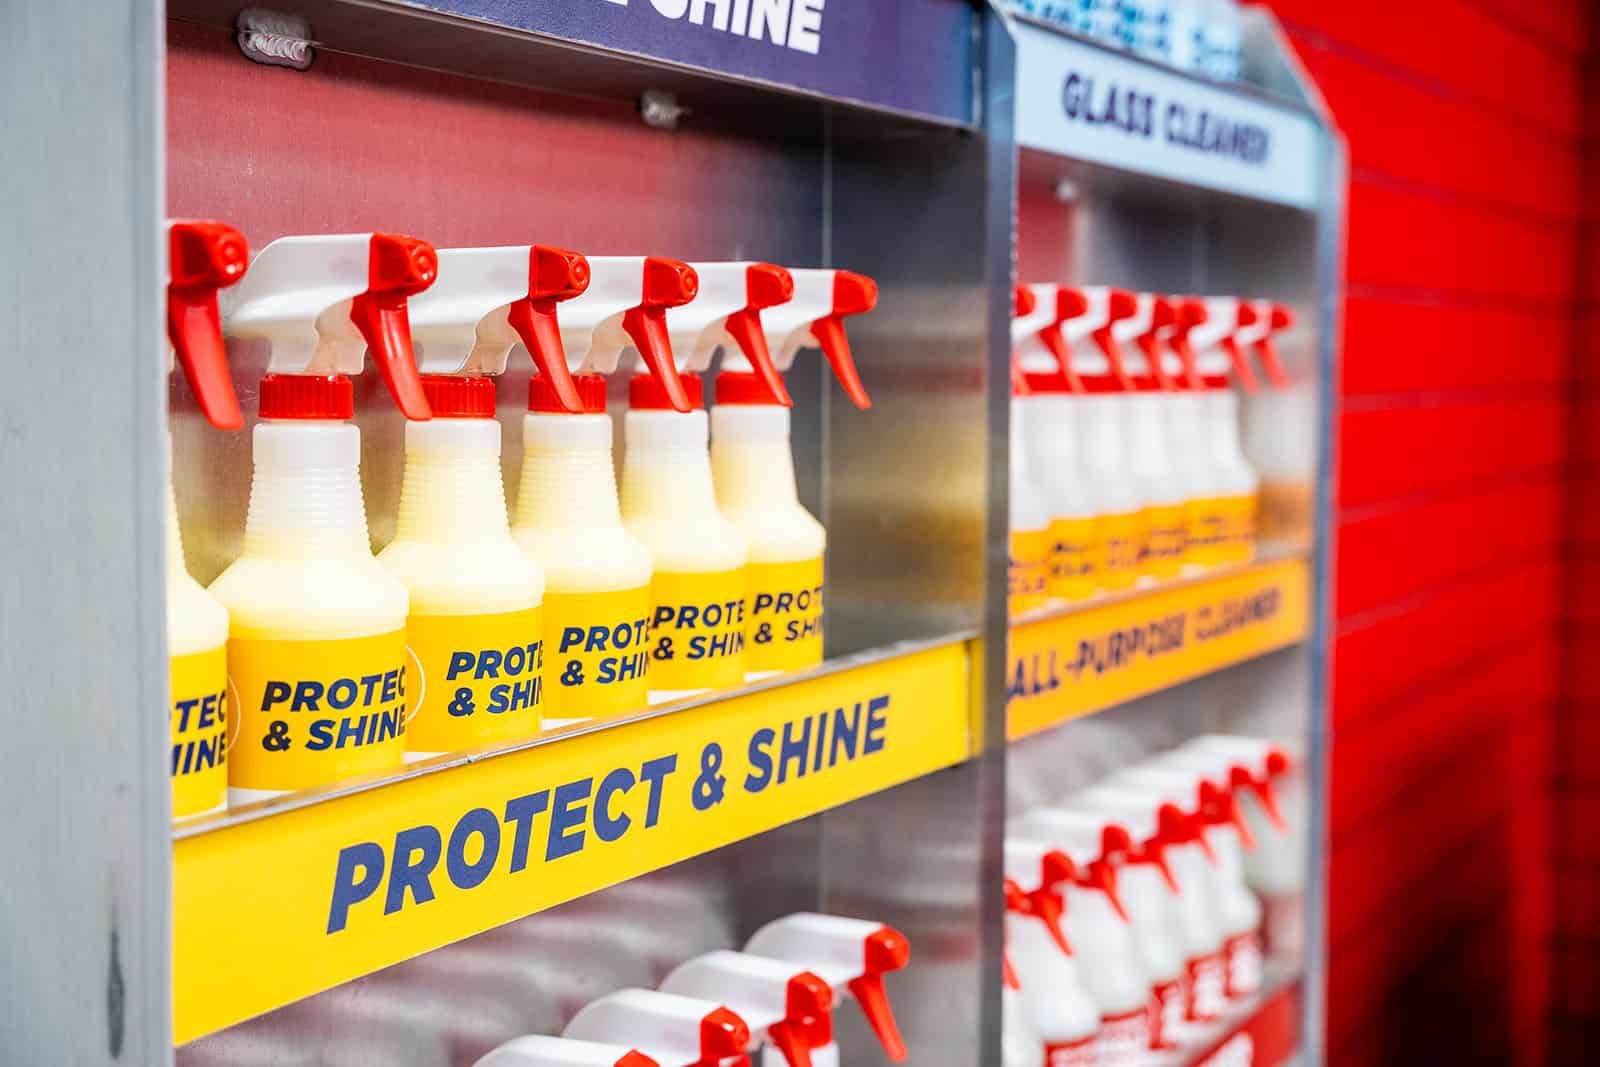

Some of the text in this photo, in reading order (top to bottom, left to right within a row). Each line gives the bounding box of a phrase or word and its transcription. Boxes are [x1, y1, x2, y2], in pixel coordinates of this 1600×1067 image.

[1060, 72, 1156, 138] GLASS
[653, 637, 674, 660] &
[754, 622, 772, 644] &
[560, 660, 584, 687] &
[447, 687, 475, 718] &
[262, 703, 406, 753] & SHINE
[326, 694, 891, 936] PROTECT & SHINE
